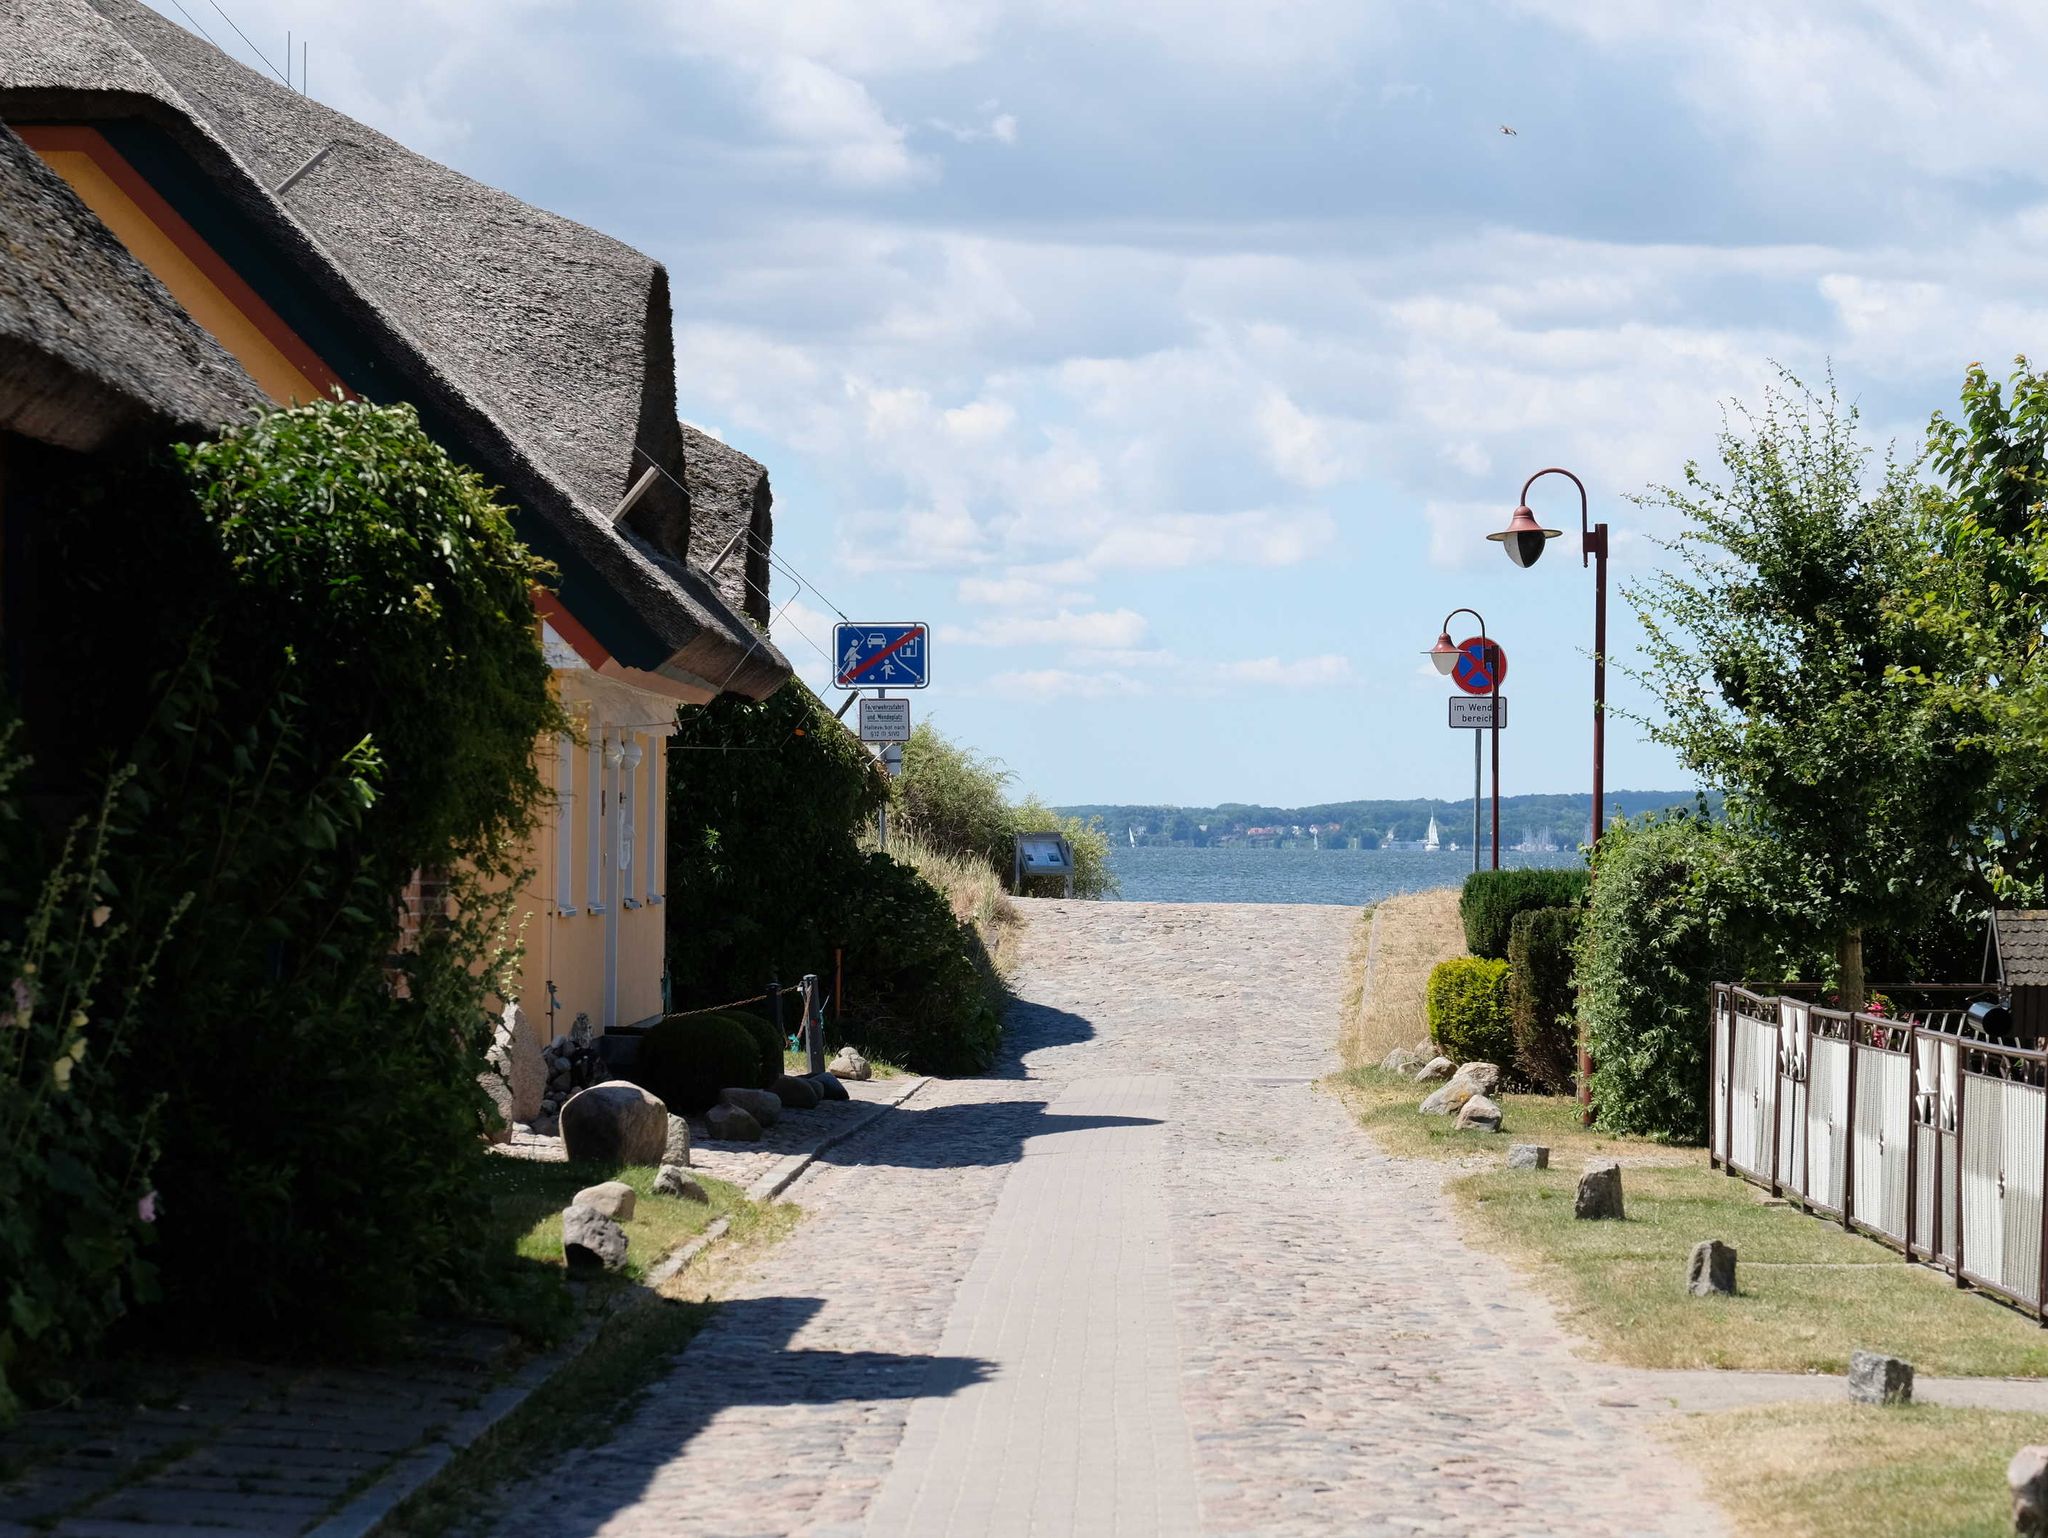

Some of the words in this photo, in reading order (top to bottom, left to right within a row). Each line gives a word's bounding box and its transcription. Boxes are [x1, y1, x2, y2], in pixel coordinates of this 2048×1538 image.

[1454, 703, 1465, 711] im
[1468, 703, 1502, 711] Wend-
[1462, 714, 1493, 722] bereich
